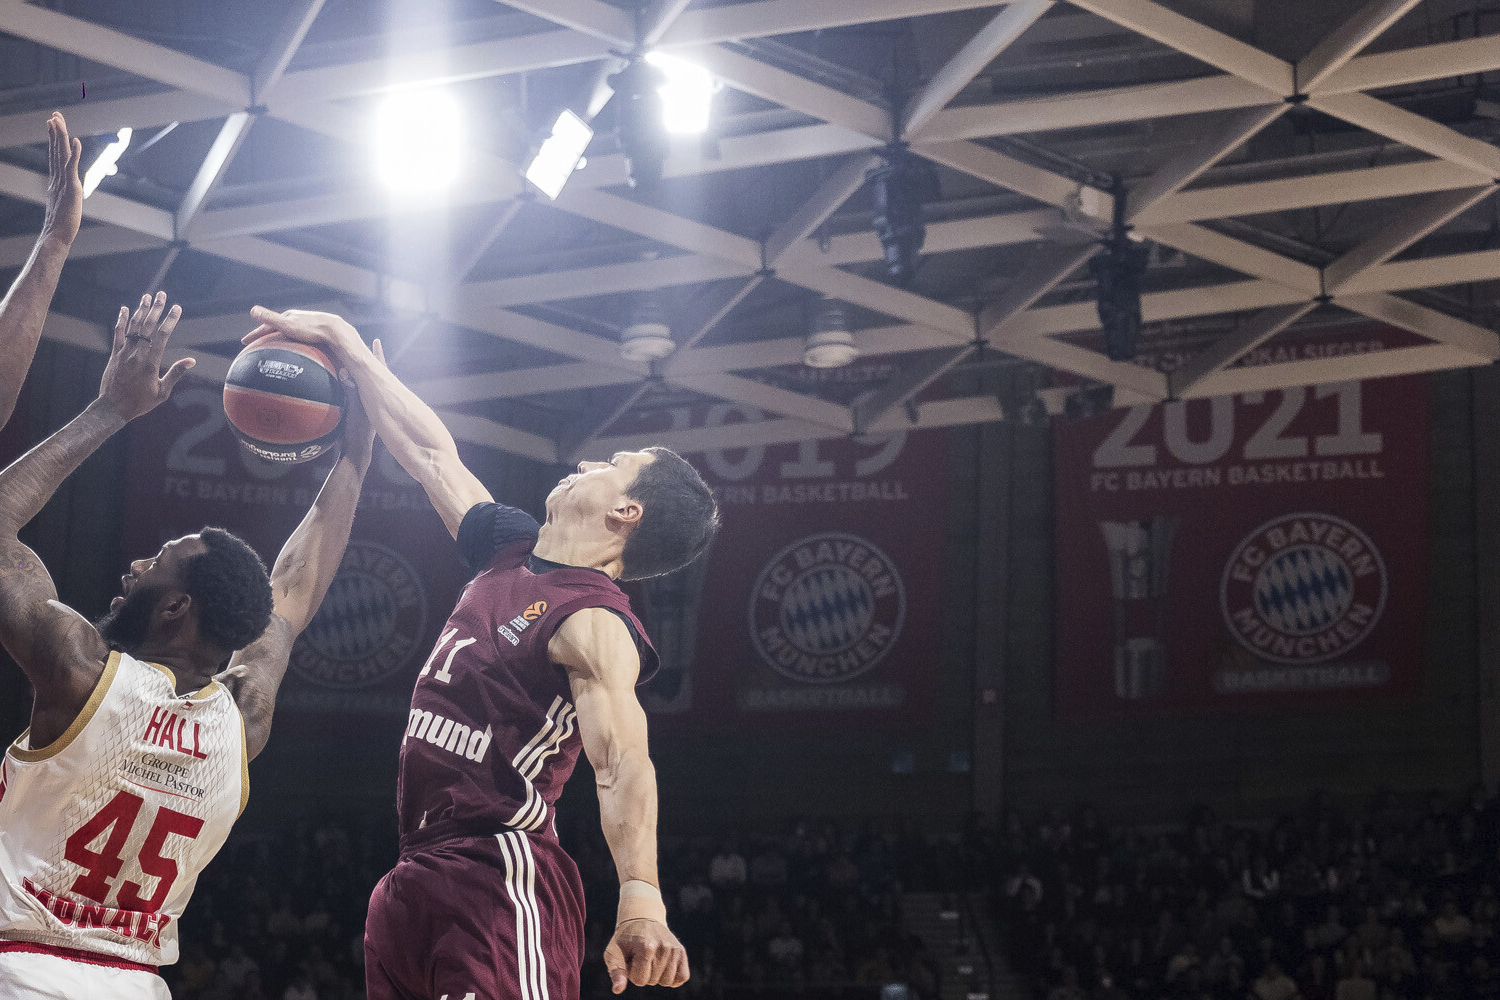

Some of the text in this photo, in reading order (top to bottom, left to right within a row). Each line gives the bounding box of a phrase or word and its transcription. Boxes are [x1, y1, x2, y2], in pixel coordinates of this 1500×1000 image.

[1093, 380, 1384, 467] 2021
[1126, 466, 1220, 491] BAYERN
[1228, 459, 1385, 485] BASKETBALL
[143, 705, 207, 760] HALL
[404, 708, 493, 764] mund
[118, 759, 205, 799] MICHEL PASTOR
[141, 753, 190, 779] GROUPE
[64, 790, 205, 914] 45
